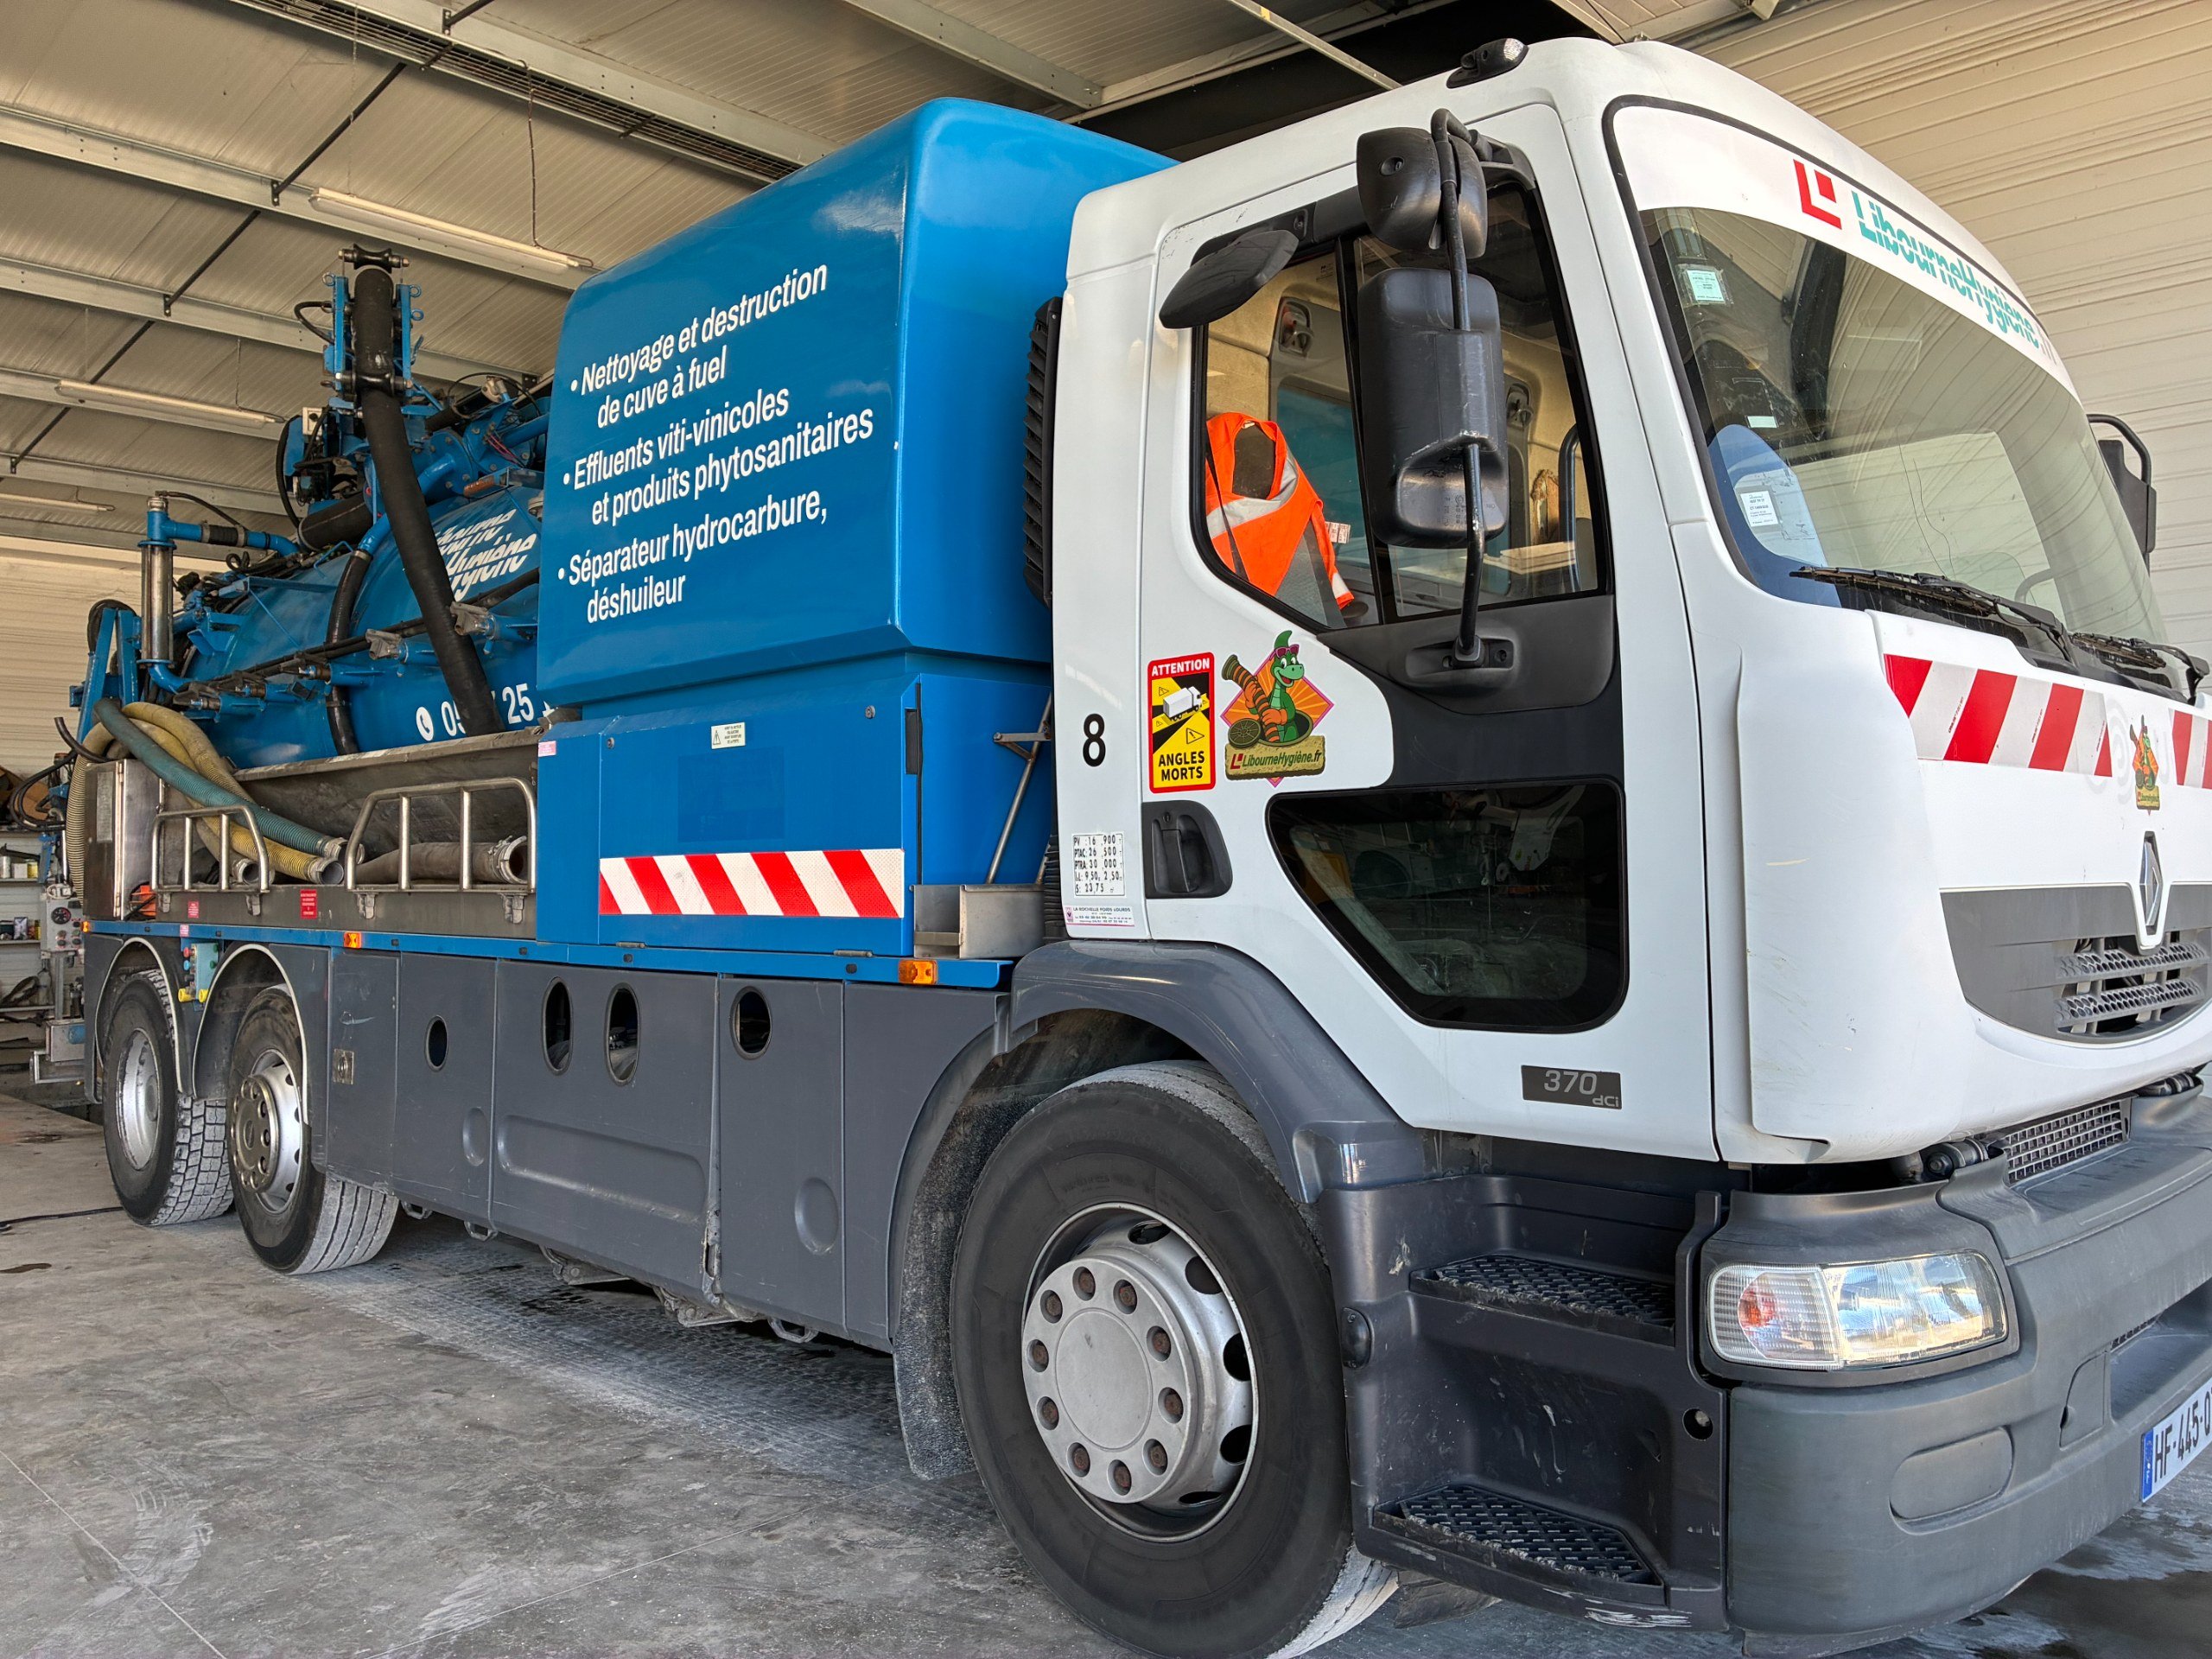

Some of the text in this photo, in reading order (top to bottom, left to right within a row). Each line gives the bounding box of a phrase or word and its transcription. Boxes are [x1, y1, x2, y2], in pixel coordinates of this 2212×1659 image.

[581, 264, 827, 396] Nettoyage et destruction
[598, 345, 728, 429] de cuve à fuel
[574, 386, 790, 490] Effluents viti-vinicoles
[592, 408, 874, 525] et produits phytosanitaires
[569, 489, 828, 587] Séparateur hydrocarbure,
[587, 575, 686, 624] déshuileur
[1152, 658, 1210, 677] ATTENTION
[502, 683, 535, 724] 25
[1083, 714, 1106, 767] 8
[1159, 750, 1205, 767] ANGLES
[1242, 749, 1322, 767] LibourneHygiène.fr
[1161, 766, 1204, 782] MORTS
[1543, 1070, 1598, 1095] 370
